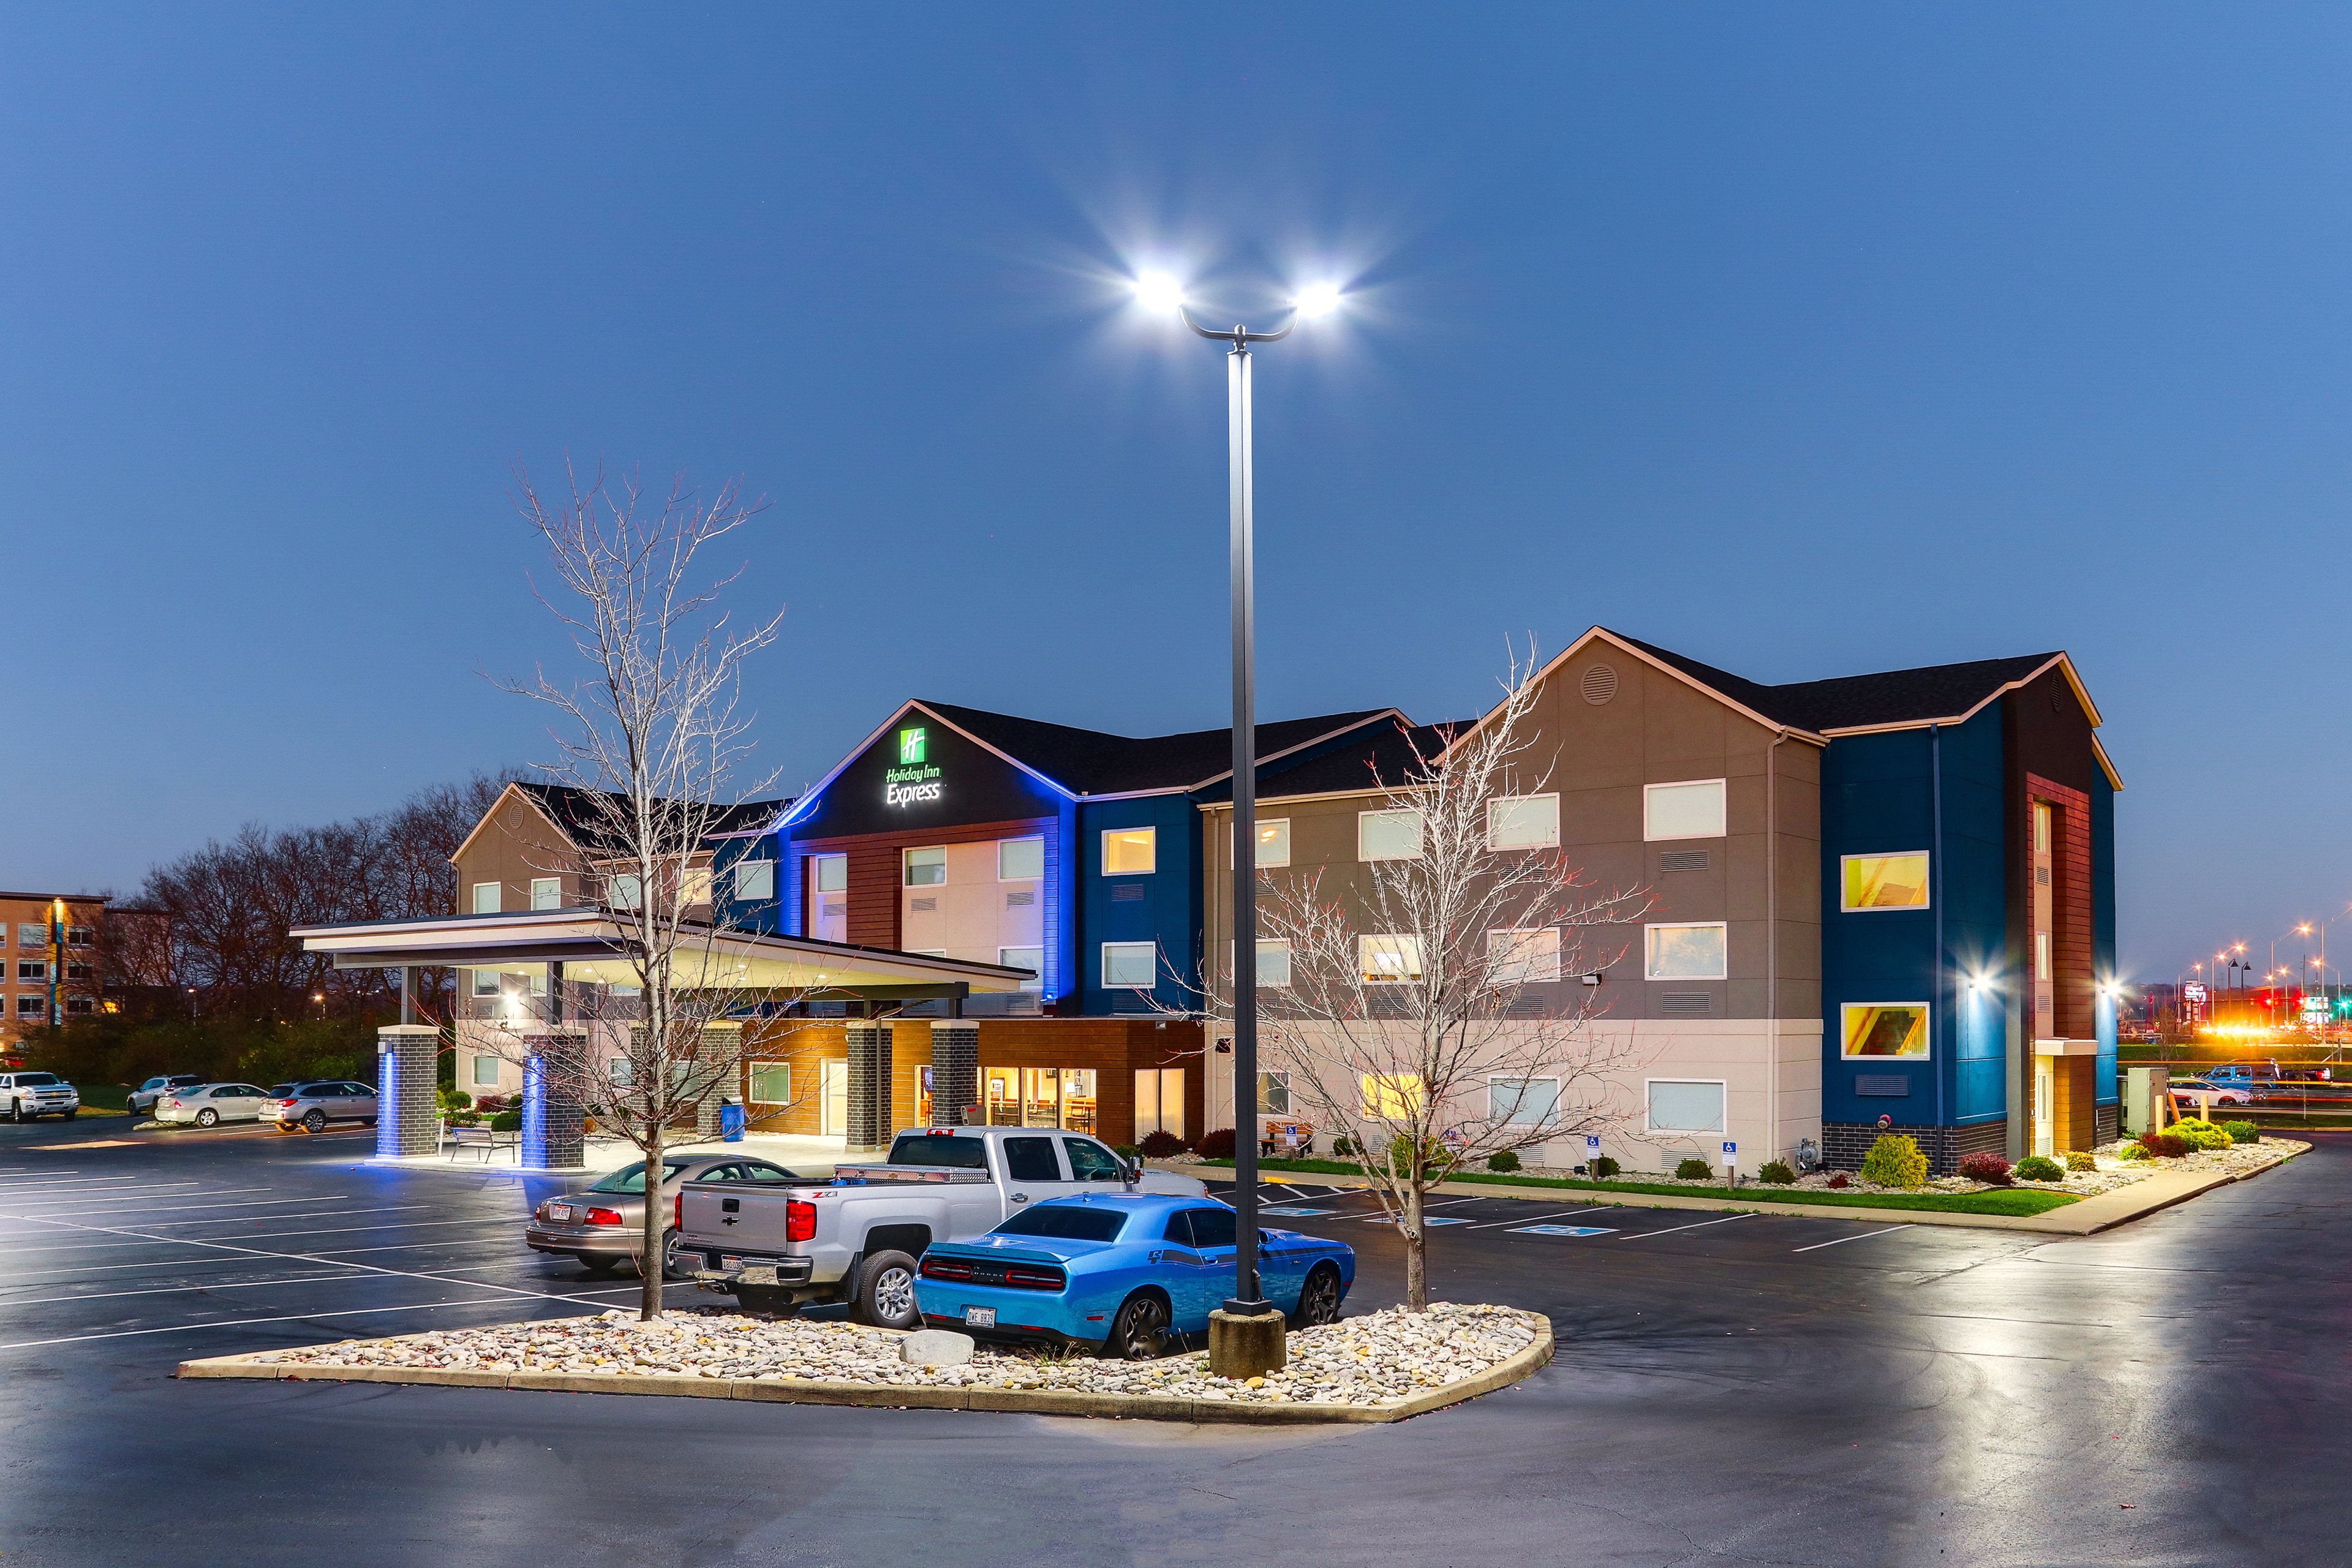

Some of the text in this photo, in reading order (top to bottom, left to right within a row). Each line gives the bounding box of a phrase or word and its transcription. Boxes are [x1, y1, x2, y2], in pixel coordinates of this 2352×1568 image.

[886, 764, 940, 783] Holiday Inn
[886, 783, 940, 808] Express
